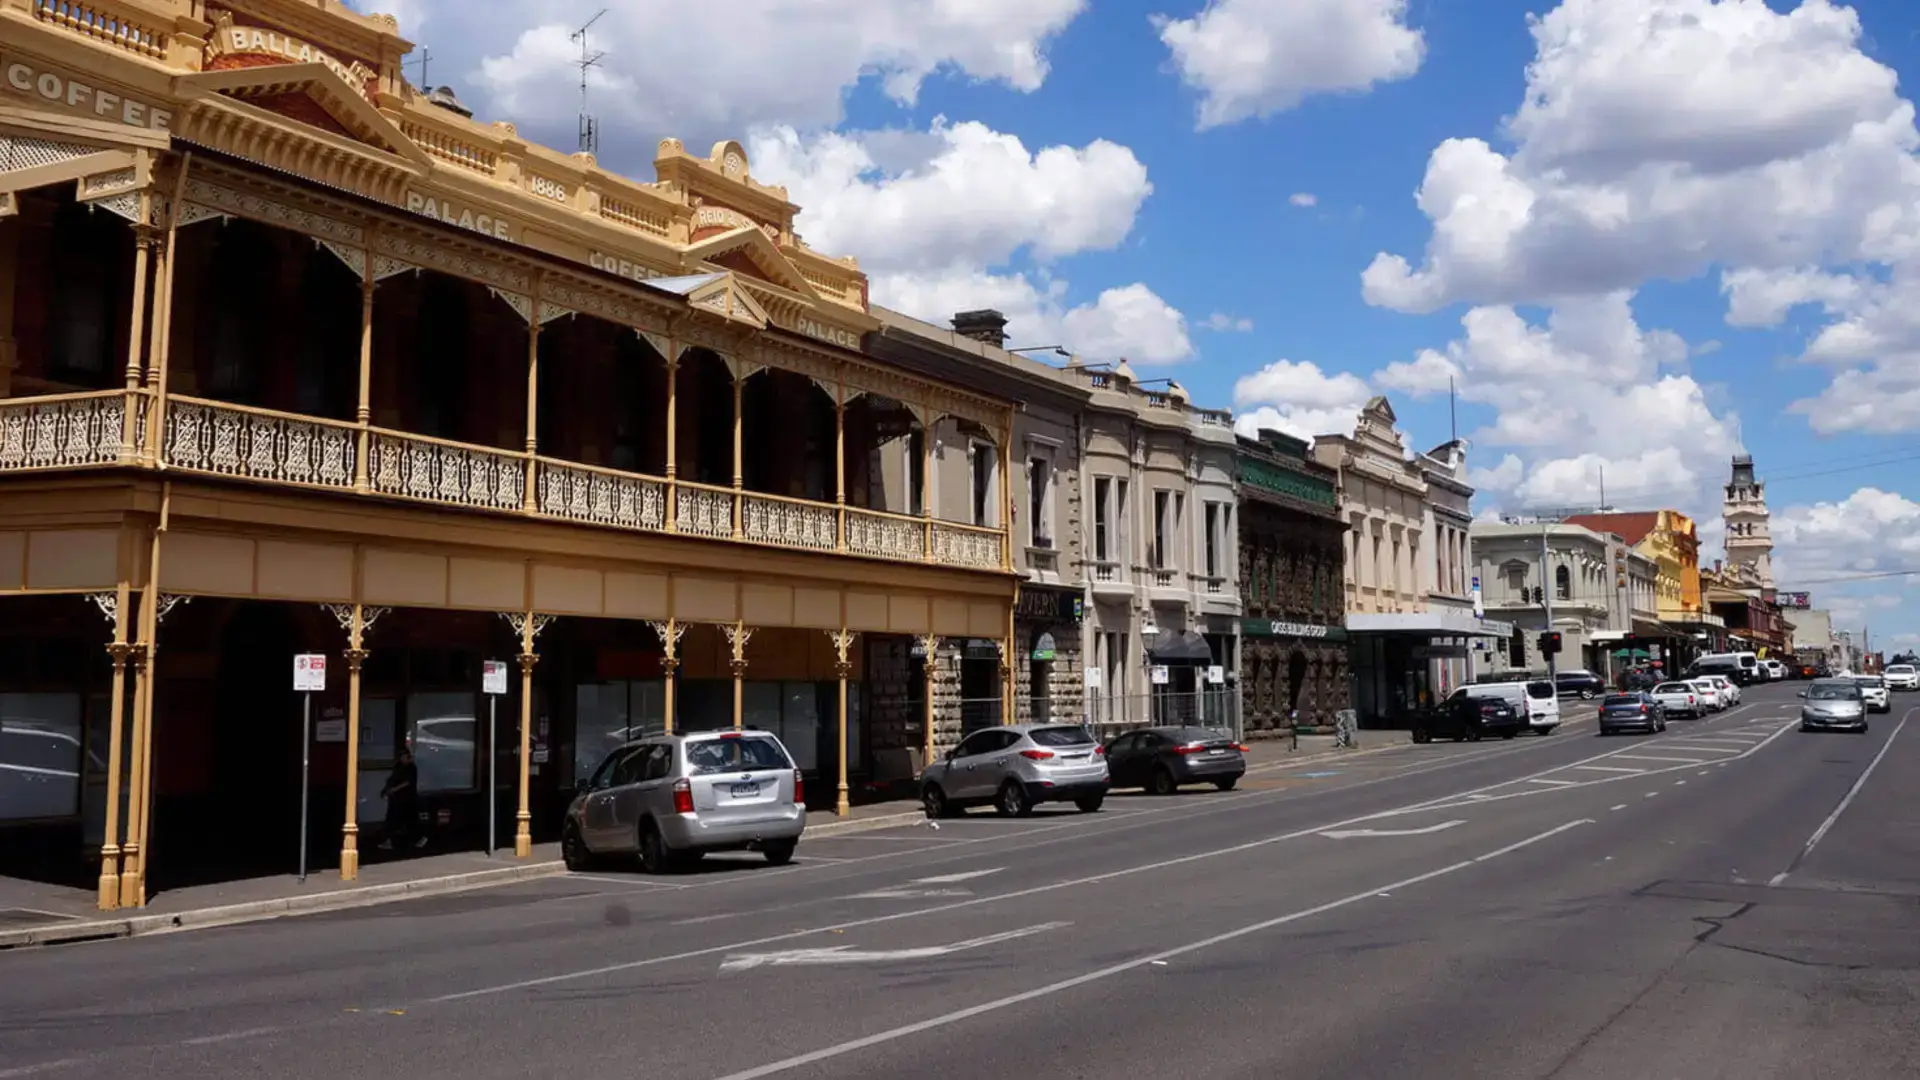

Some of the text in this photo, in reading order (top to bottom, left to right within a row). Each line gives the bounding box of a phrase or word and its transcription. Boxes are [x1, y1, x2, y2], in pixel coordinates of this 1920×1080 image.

[8, 64, 172, 130] COFFEE
[532, 176, 566, 203] 1886
[699, 210, 724, 225] REID
[589, 252, 669, 283] COFFE
[798, 318, 857, 348] PALACE
